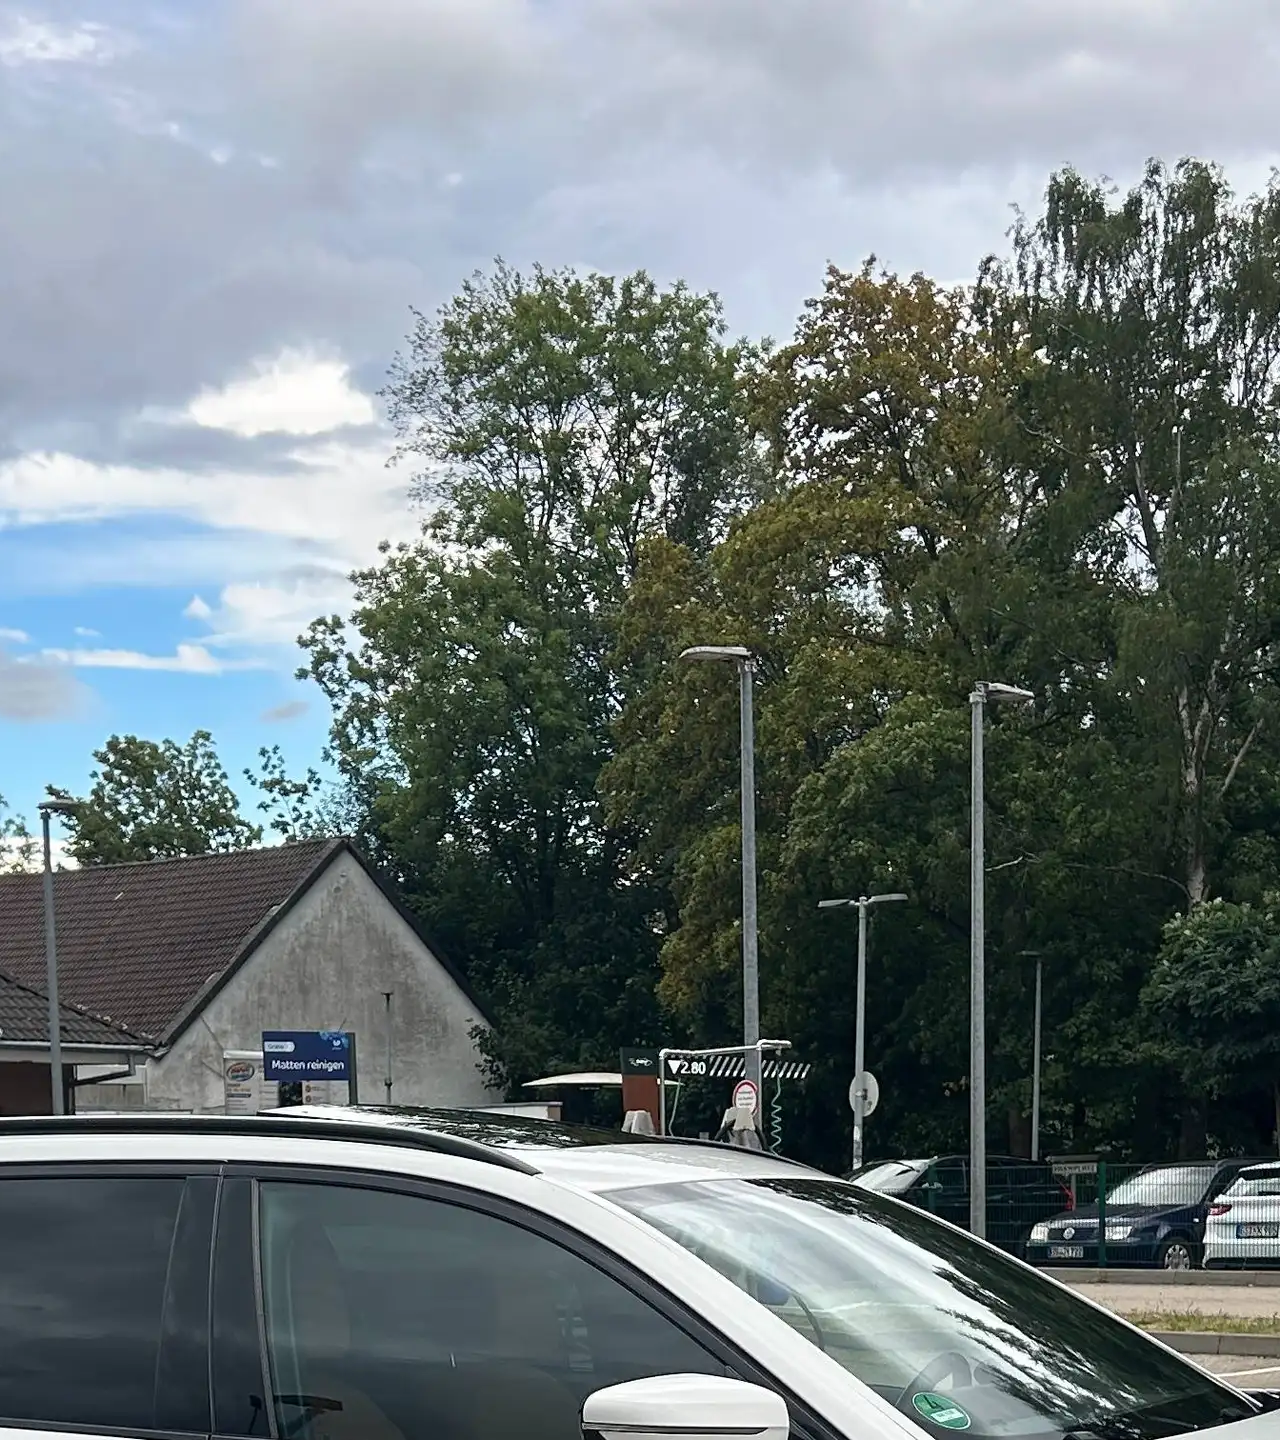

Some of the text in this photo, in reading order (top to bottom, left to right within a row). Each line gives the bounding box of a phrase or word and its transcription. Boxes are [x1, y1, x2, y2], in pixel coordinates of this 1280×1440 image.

[271, 1059, 345, 1072] Matten reinigen
[680, 1061, 707, 1075] 2.80
